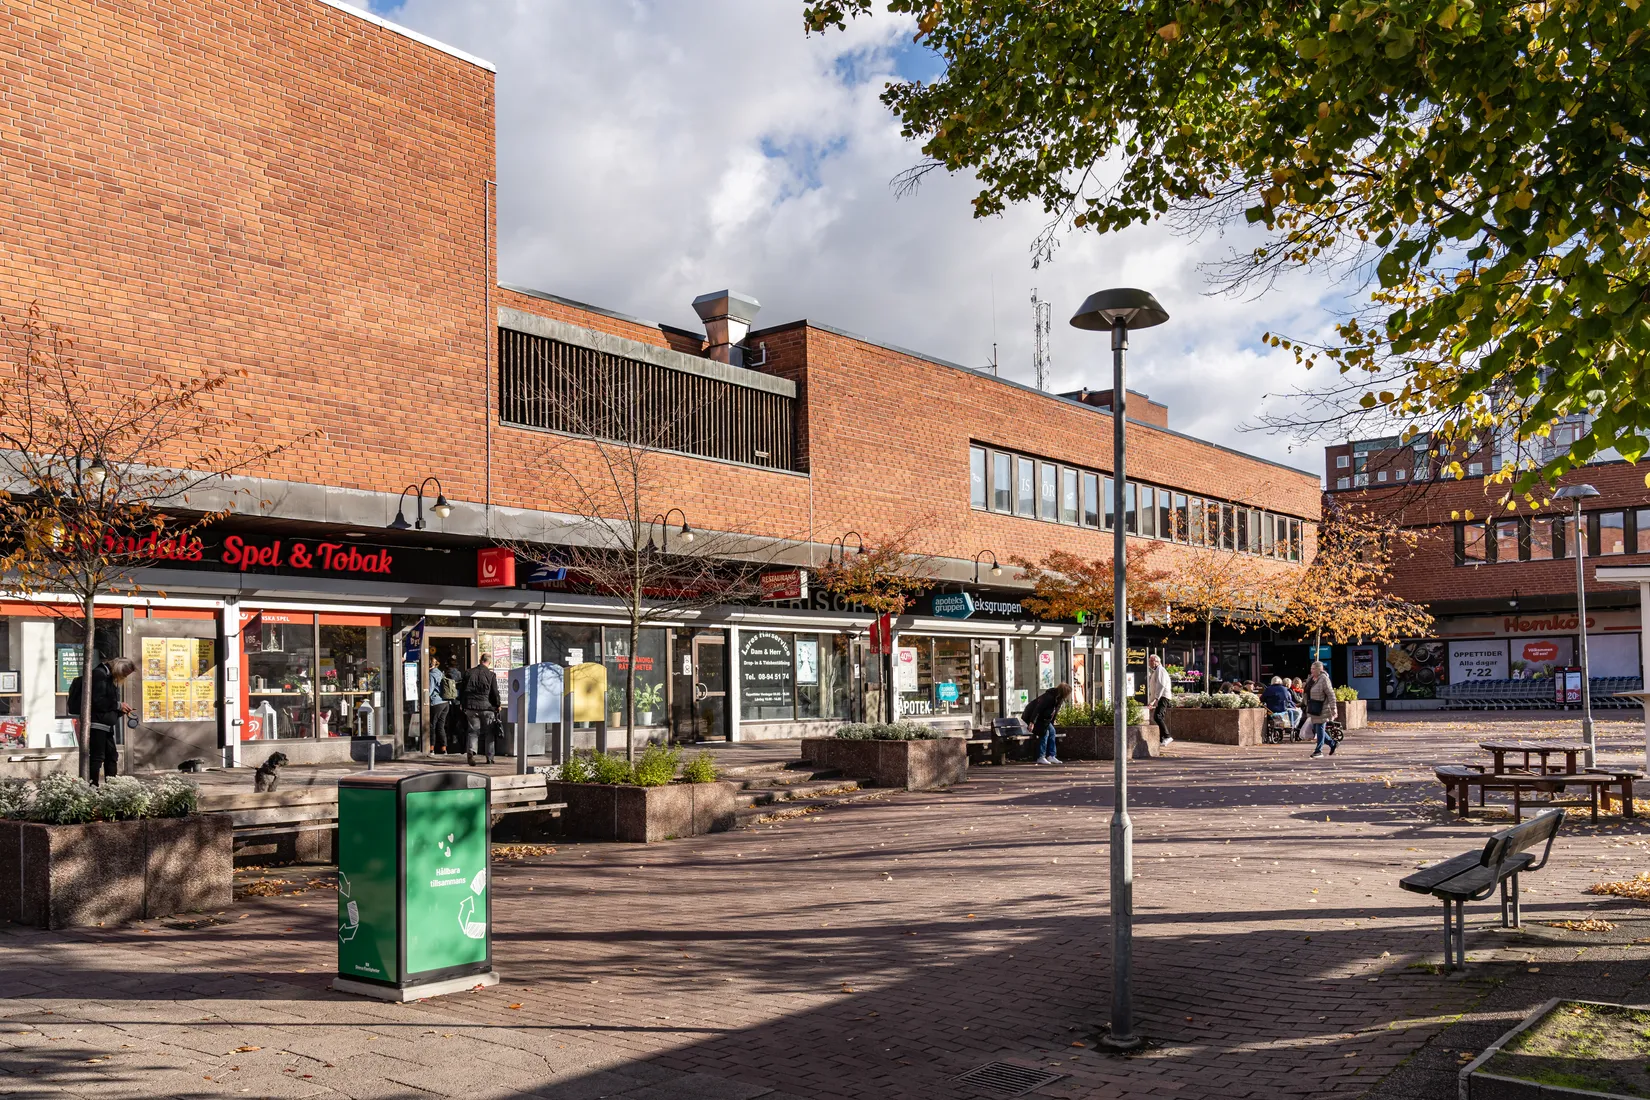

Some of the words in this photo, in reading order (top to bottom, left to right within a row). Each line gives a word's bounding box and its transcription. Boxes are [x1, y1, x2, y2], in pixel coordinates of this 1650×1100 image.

[1042, 480, 1056, 497] ÖR
[222, 535, 282, 571] Spel
[290, 543, 312, 568] &
[317, 543, 393, 574] Tobak
[935, 596, 963, 605] apoteks
[972, 598, 1022, 615] teksgruppen
[935, 604, 965, 613] gruppen
[1082, 615, 1112, 631] piere
[1504, 613, 1595, 632] Hemköp
[741, 634, 758, 656] Lares
[900, 652, 912, 660] 40%
[1465, 668, 1492, 677] 7-22
[899, 700, 931, 714] APOTEK
[436, 867, 460, 876] Hållbara
[430, 878, 466, 887] tillsammans
